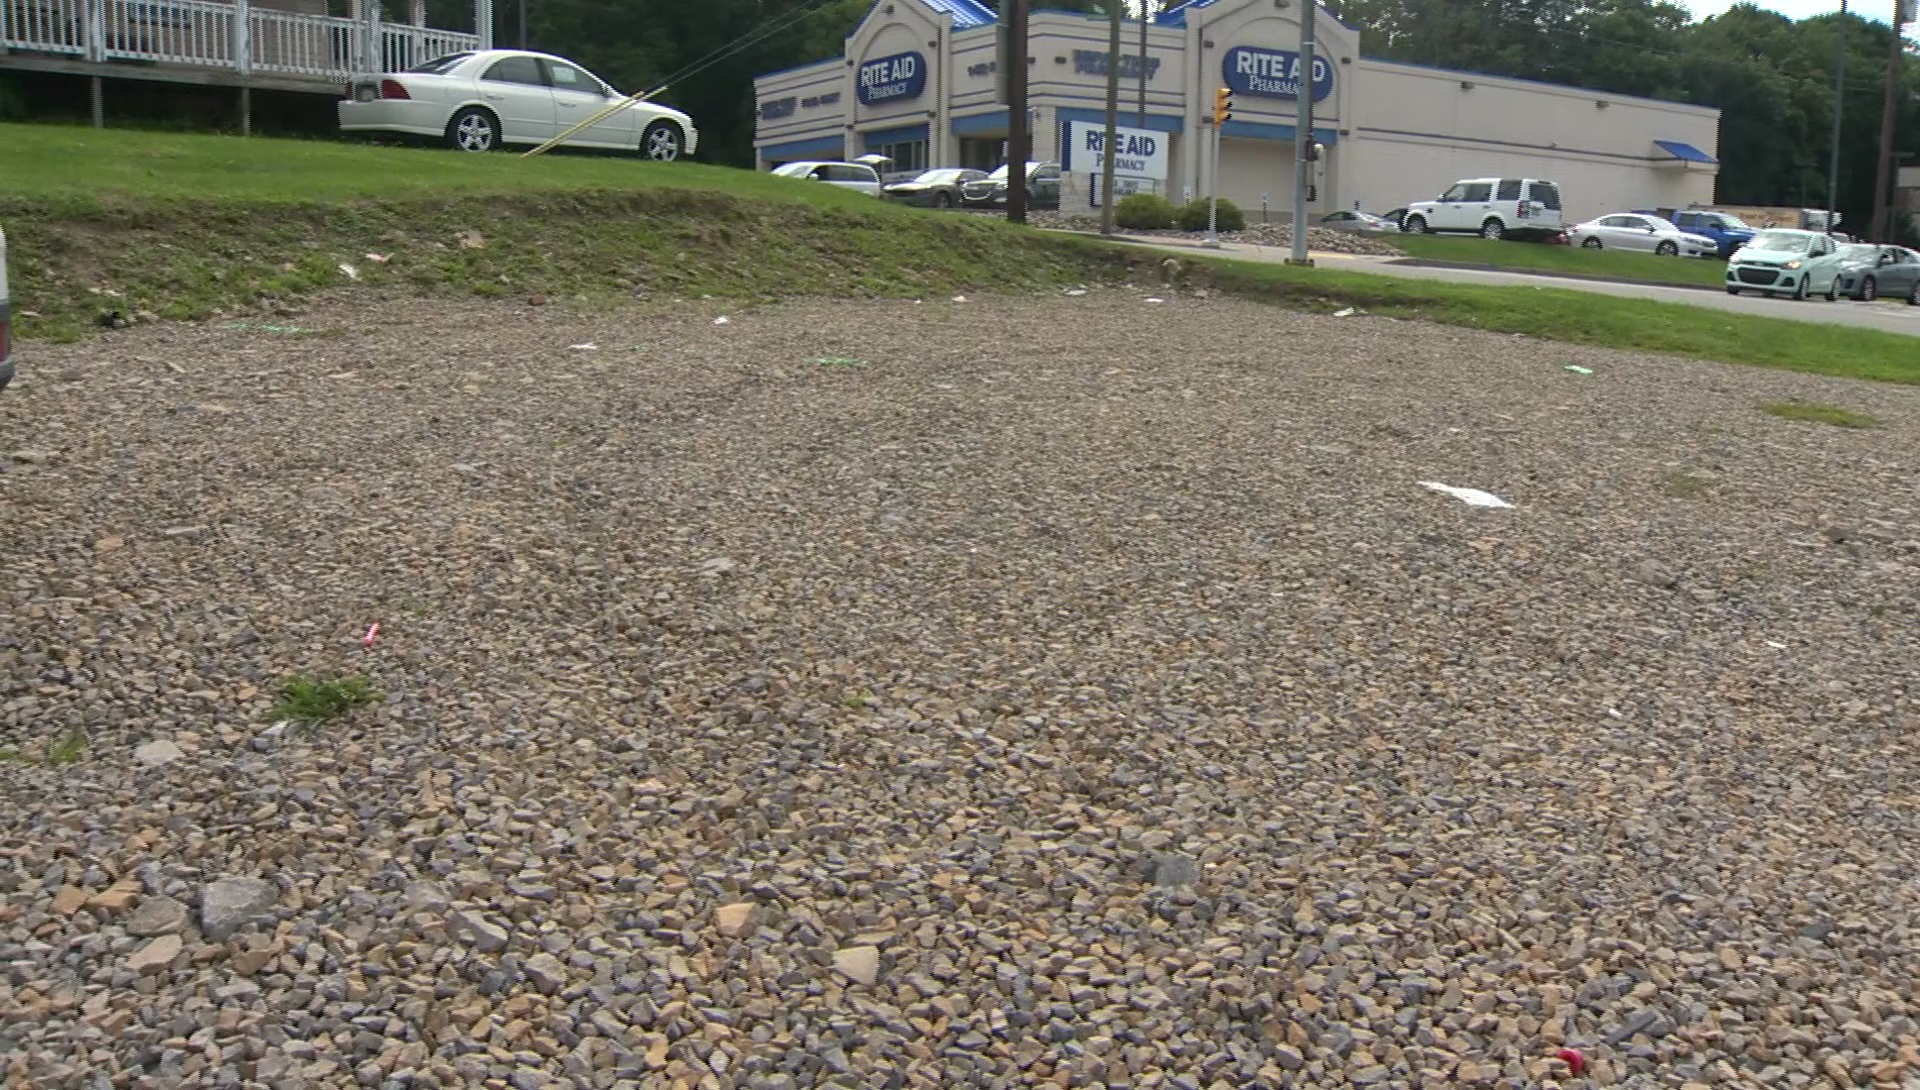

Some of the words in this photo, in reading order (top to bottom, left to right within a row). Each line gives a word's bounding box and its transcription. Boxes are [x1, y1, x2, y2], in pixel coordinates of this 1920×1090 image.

[860, 61, 889, 87] RITE
[891, 56, 915, 81] AID
[1237, 51, 1285, 78] RITE
[1288, 57, 1325, 82] AD
[1249, 75, 1300, 95] PHARMA
[1126, 135, 1156, 157] AID
[1096, 152, 1146, 172] PRMACY
